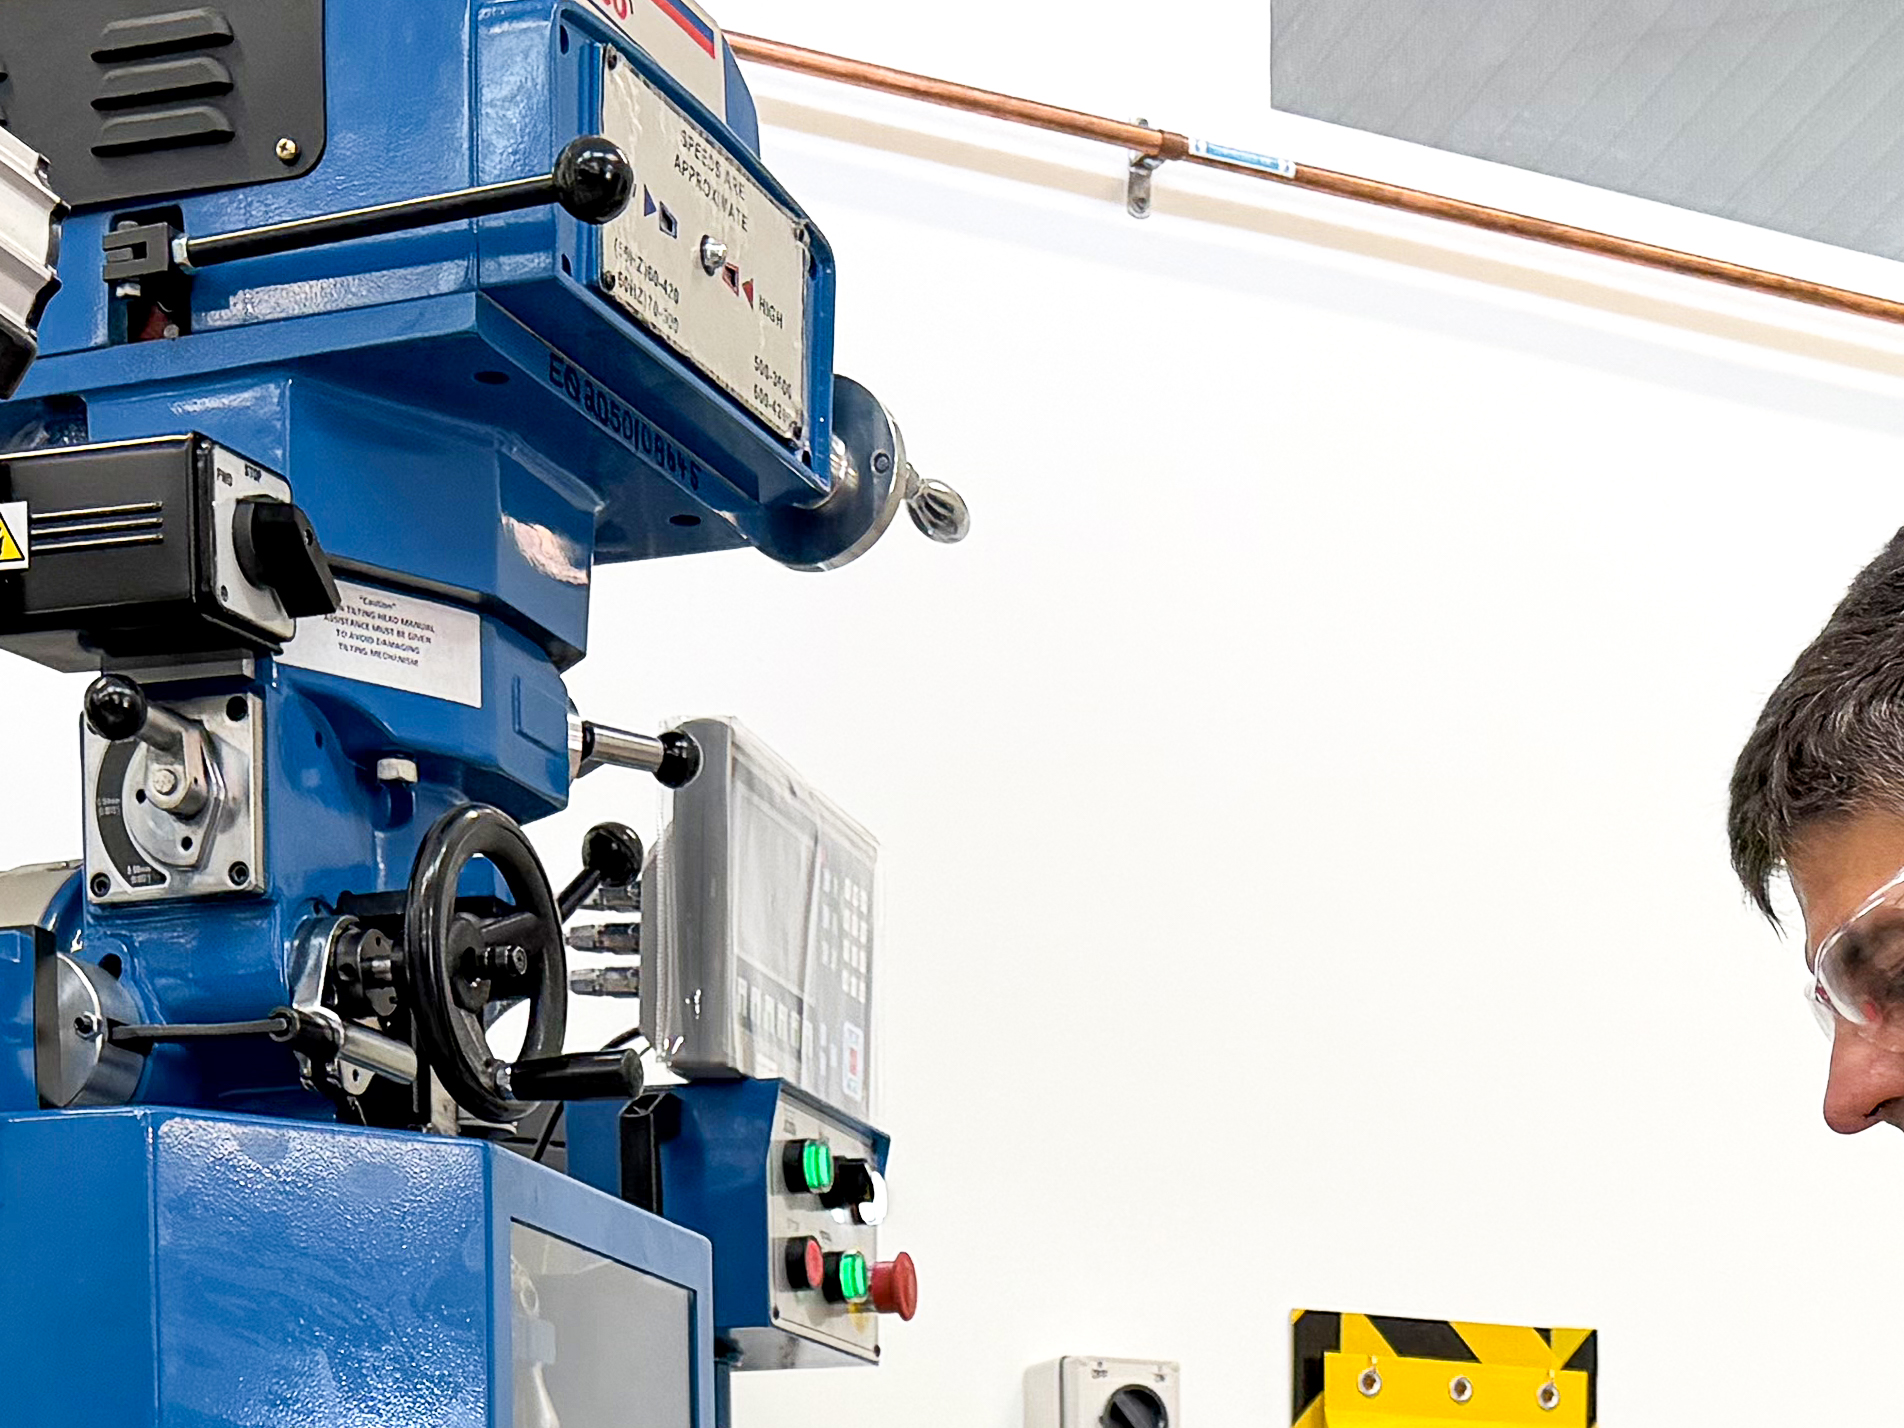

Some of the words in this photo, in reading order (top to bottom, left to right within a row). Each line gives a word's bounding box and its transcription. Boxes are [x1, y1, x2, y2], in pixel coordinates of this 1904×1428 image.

[673, 153, 749, 233] APPROXIMATE
[680, 129, 721, 178] SPEEDS
[724, 168, 747, 201] ARE
[758, 294, 784, 330] HIGH
